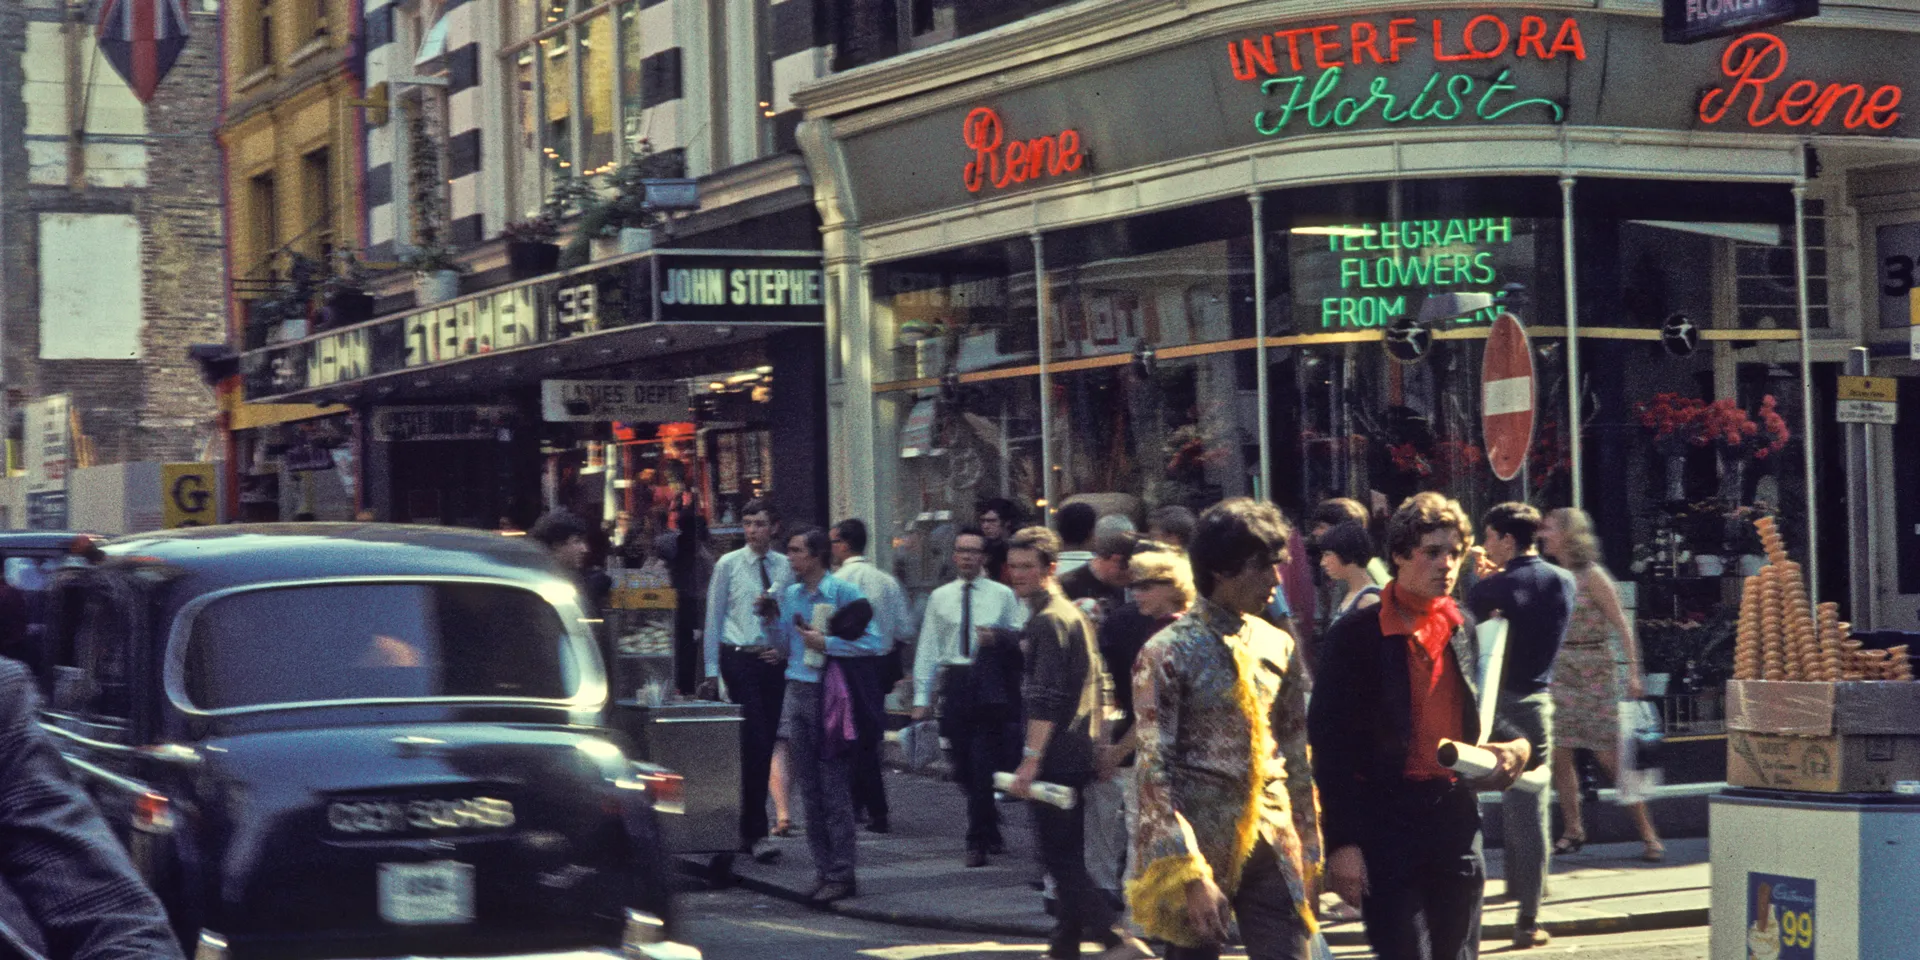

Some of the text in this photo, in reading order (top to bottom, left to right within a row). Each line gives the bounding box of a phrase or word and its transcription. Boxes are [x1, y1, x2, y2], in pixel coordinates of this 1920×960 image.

[1699, 32, 1902, 129] Rene
[1254, 66, 1564, 135] Florist
[962, 106, 1085, 192] Rene
[1327, 216, 1512, 251] TELEGRAPH
[661, 268, 824, 305] JOHN STEPHE
[1341, 252, 1496, 289] FLOWERS
[404, 286, 538, 367] STEPHEN
[557, 284, 597, 324] 33
[1321, 295, 1406, 327] FROM
[1782, 910, 1813, 949] 99
